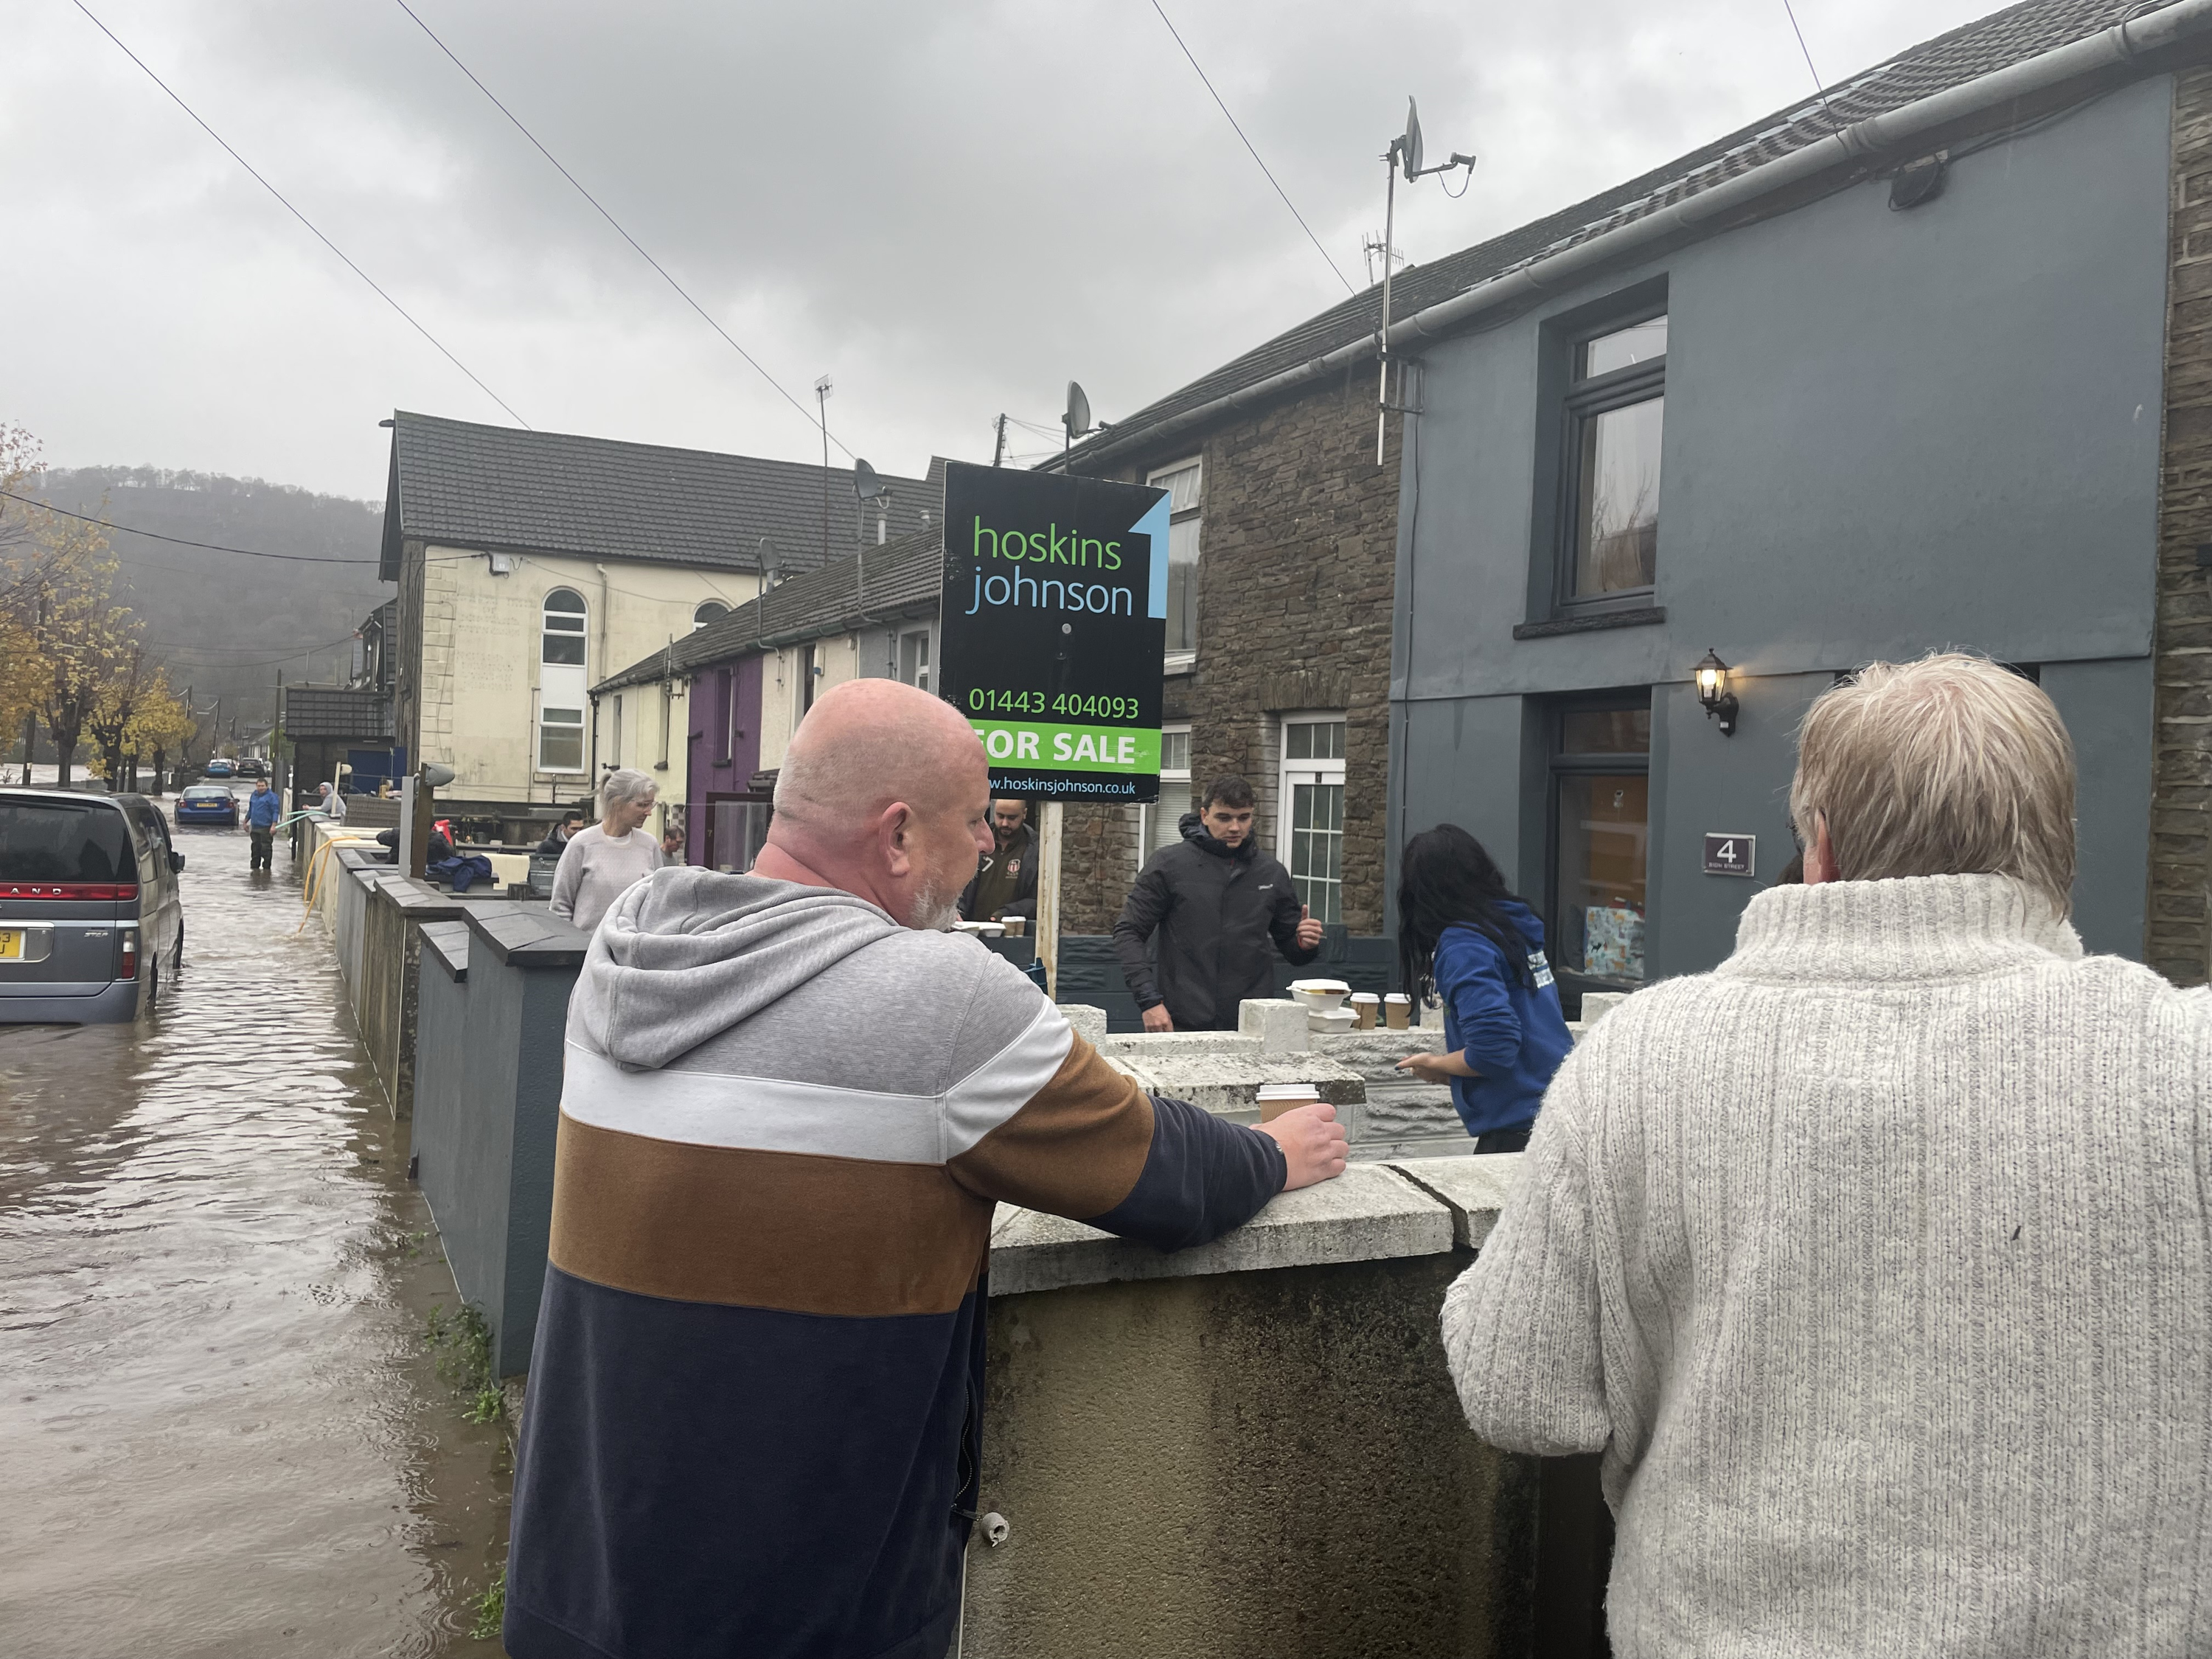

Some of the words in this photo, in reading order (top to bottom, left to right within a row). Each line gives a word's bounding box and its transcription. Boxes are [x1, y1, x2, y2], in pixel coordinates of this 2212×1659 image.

[974, 515, 1122, 571] hoskins
[965, 565, 1133, 616] johnson
[969, 688, 1046, 714] 01443
[1051, 693, 1139, 720] 404093
[1053, 732, 1136, 765] SALE
[1717, 839, 1737, 863] 4
[10, 887, 62, 895] AND
